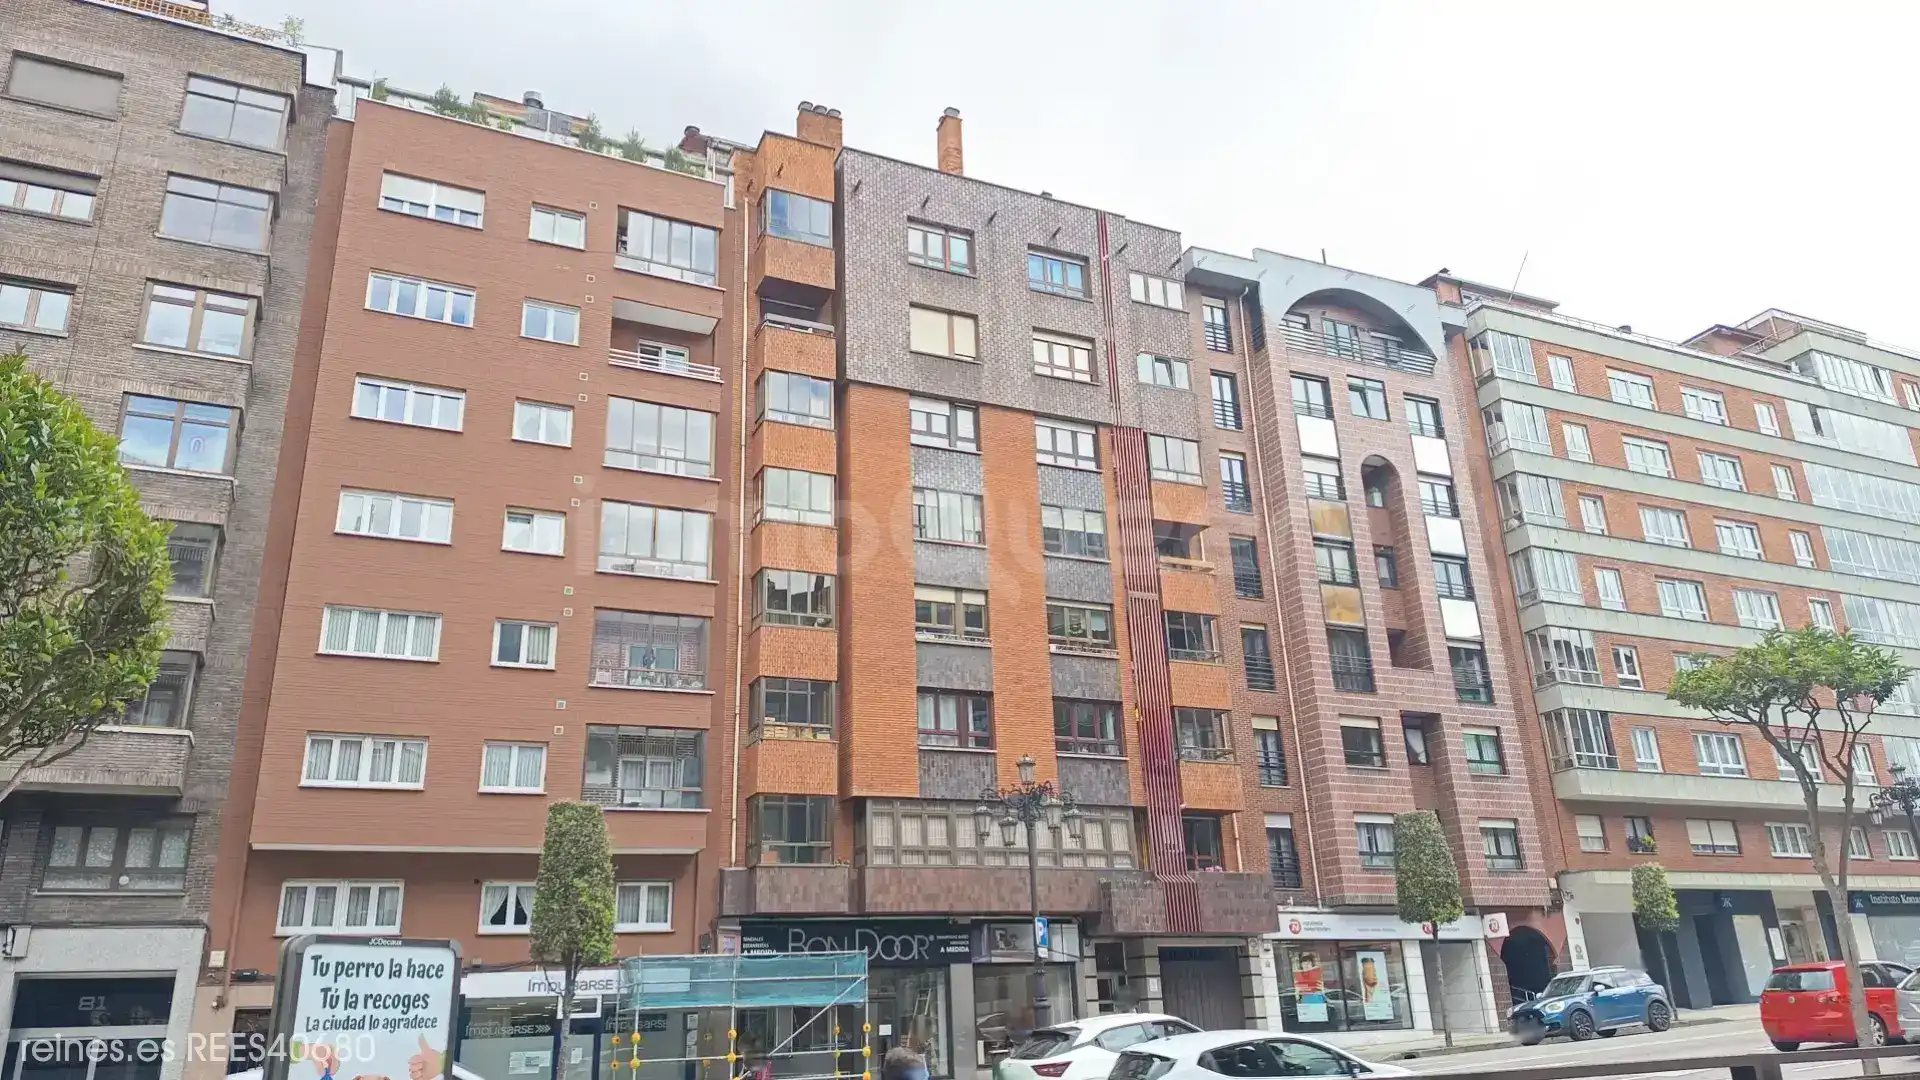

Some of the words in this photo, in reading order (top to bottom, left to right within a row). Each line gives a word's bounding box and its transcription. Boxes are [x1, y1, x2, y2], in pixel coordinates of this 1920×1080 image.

[1869, 893, 1900, 904] Instituto
[369, 938, 402, 946] JCDecaux
[311, 955, 330, 976] Tu
[334, 961, 384, 983] perro
[388, 958, 402, 979] la
[407, 958, 444, 979] hace
[78, 995, 107, 1011] 81
[320, 987, 340, 1009] Tú
[344, 989, 358, 1010] la
[363, 992, 430, 1015] recoges
[306, 1016, 320, 1032] La
[323, 1014, 366, 1031] ciudad
[369, 1014, 379, 1030] lo
[383, 1013, 438, 1033] agradece
